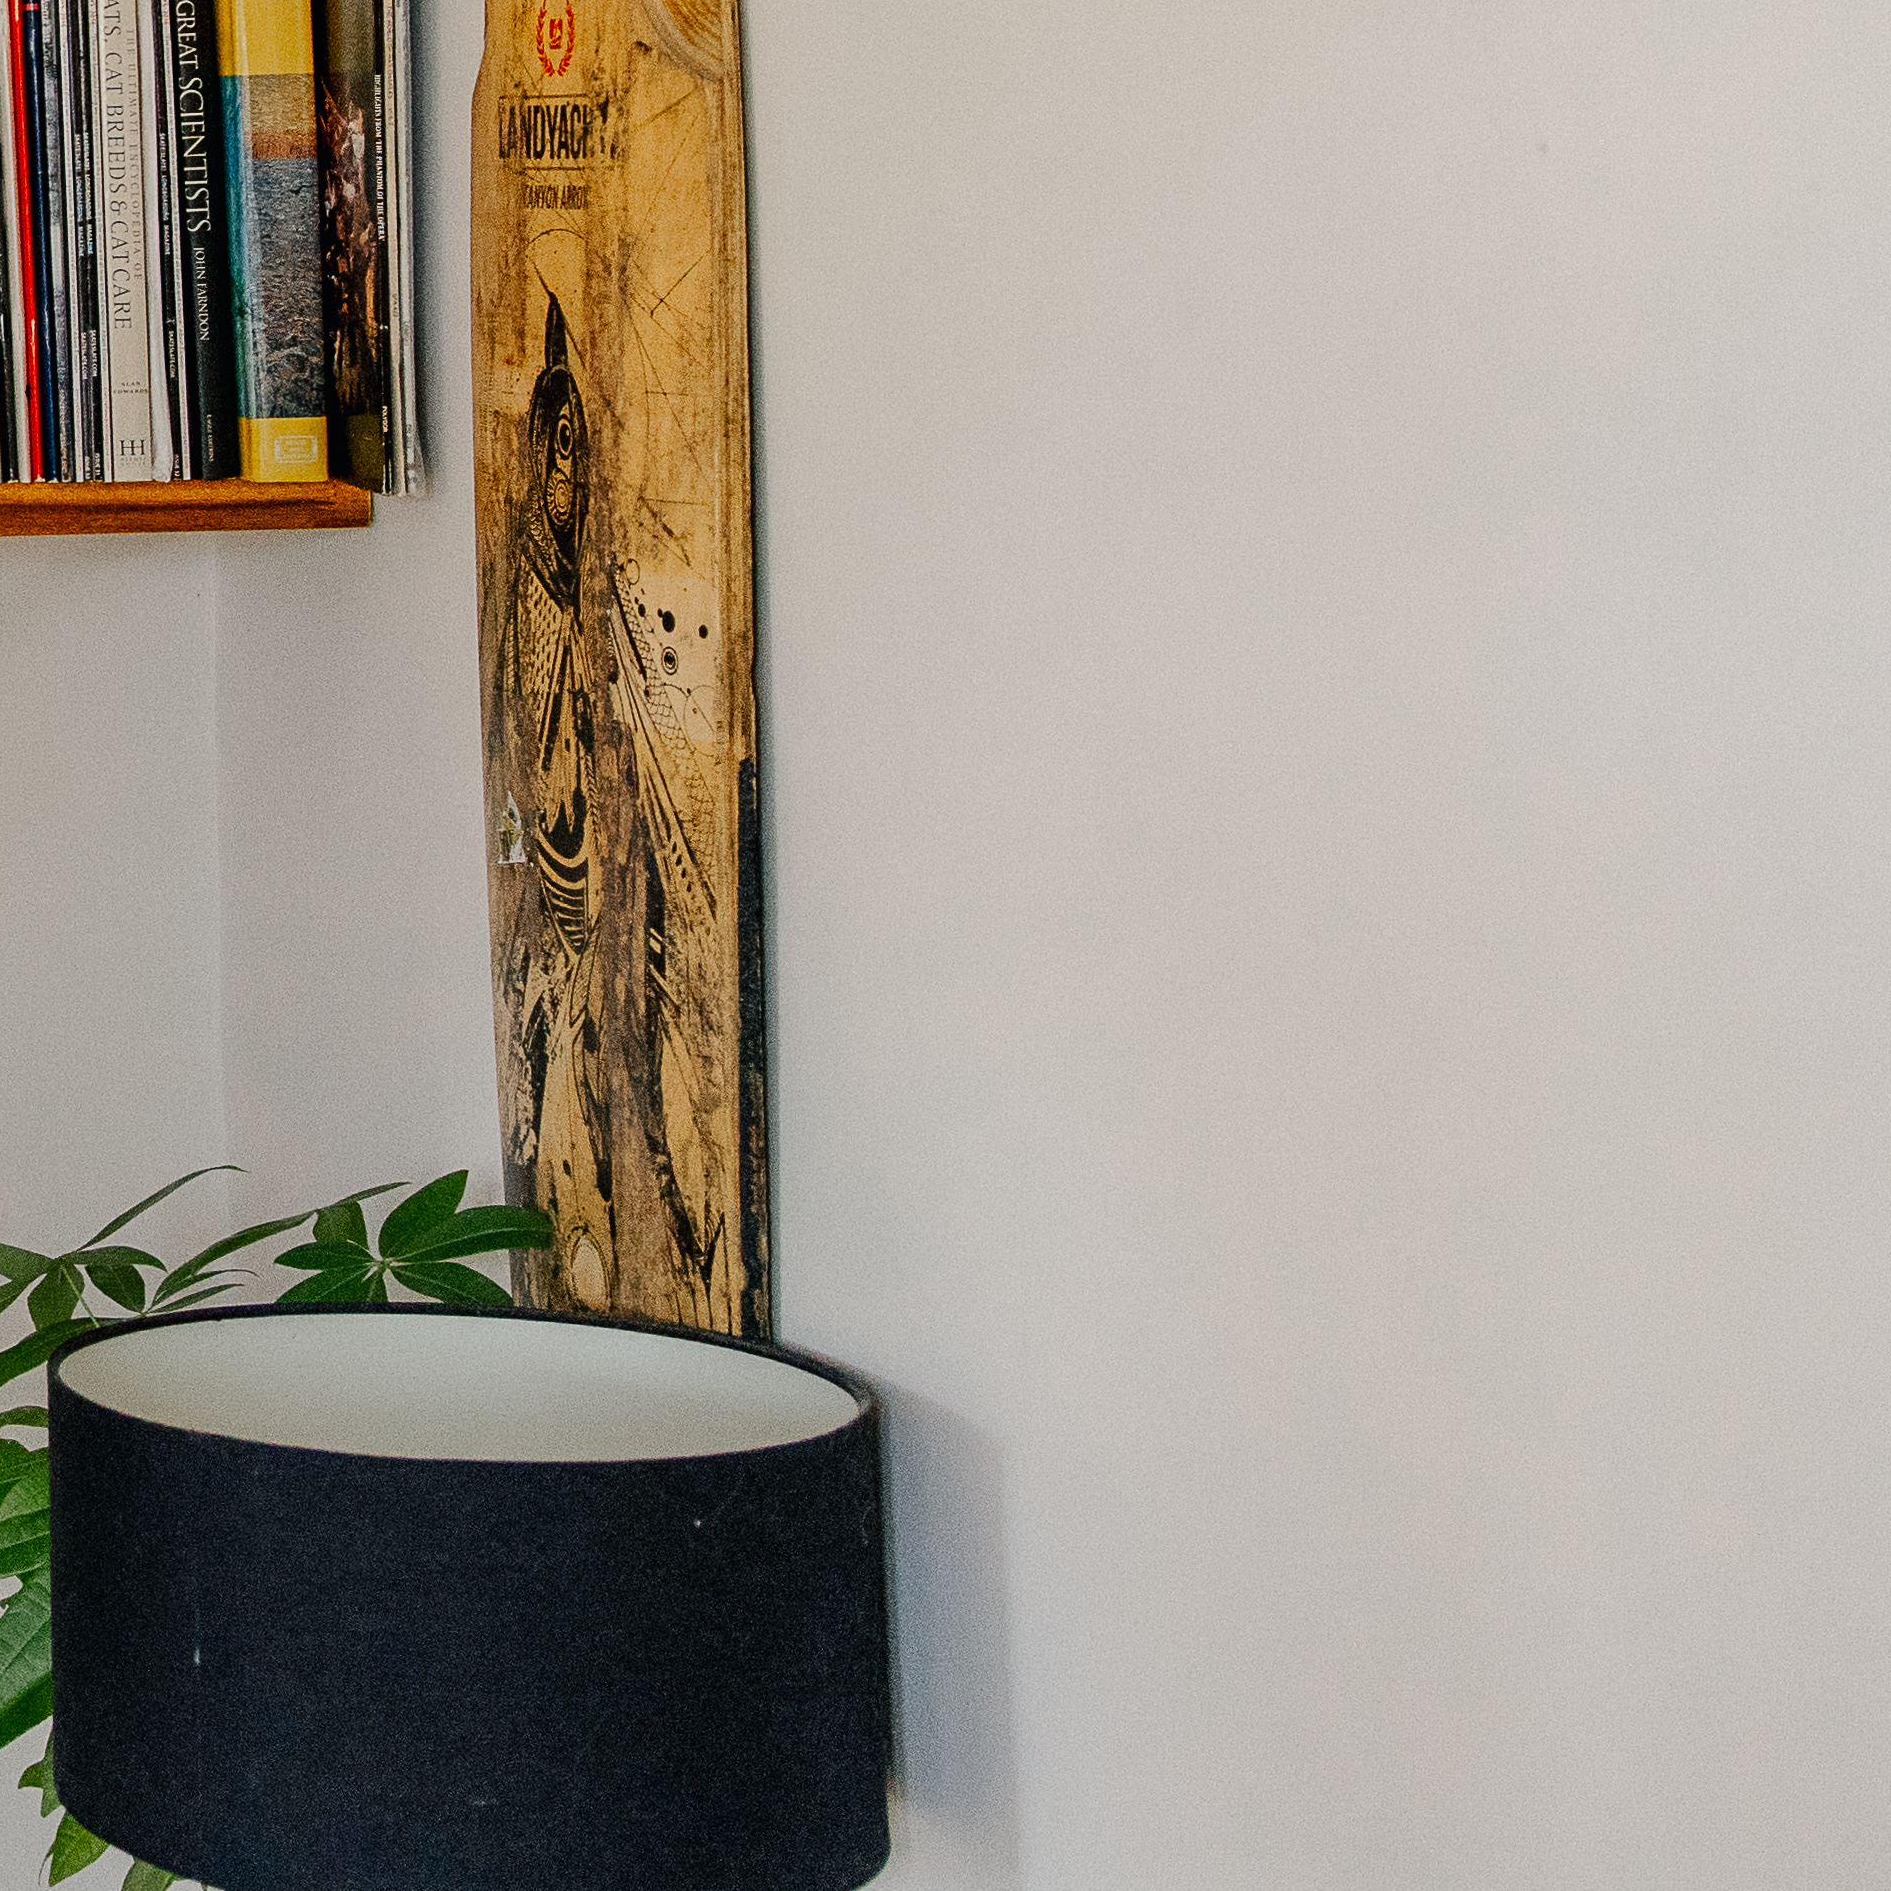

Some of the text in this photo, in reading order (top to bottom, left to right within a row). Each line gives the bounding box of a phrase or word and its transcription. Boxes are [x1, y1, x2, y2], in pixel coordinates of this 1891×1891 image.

[124, 29, 134, 55] THE
[174, 0, 198, 71] GREAT
[102, 51, 123, 95] CAT
[372, 74, 382, 117] HIGHLIGHTS
[124, 63, 138, 136] ULTIMATE
[104, 104, 127, 193] BREEDS
[374, 118, 382, 138] FROM
[178, 75, 211, 233] SCIENTISTS
[374, 156, 383, 190] PHANTOM
[108, 198, 127, 215] &
[126, 143, 142, 254] ENCYCLOPEDIA
[109, 219, 129, 264] CAT
[192, 246, 207, 278] JOHN
[110, 267, 132, 329] CARE
[195, 281, 210, 342] FARNDON
